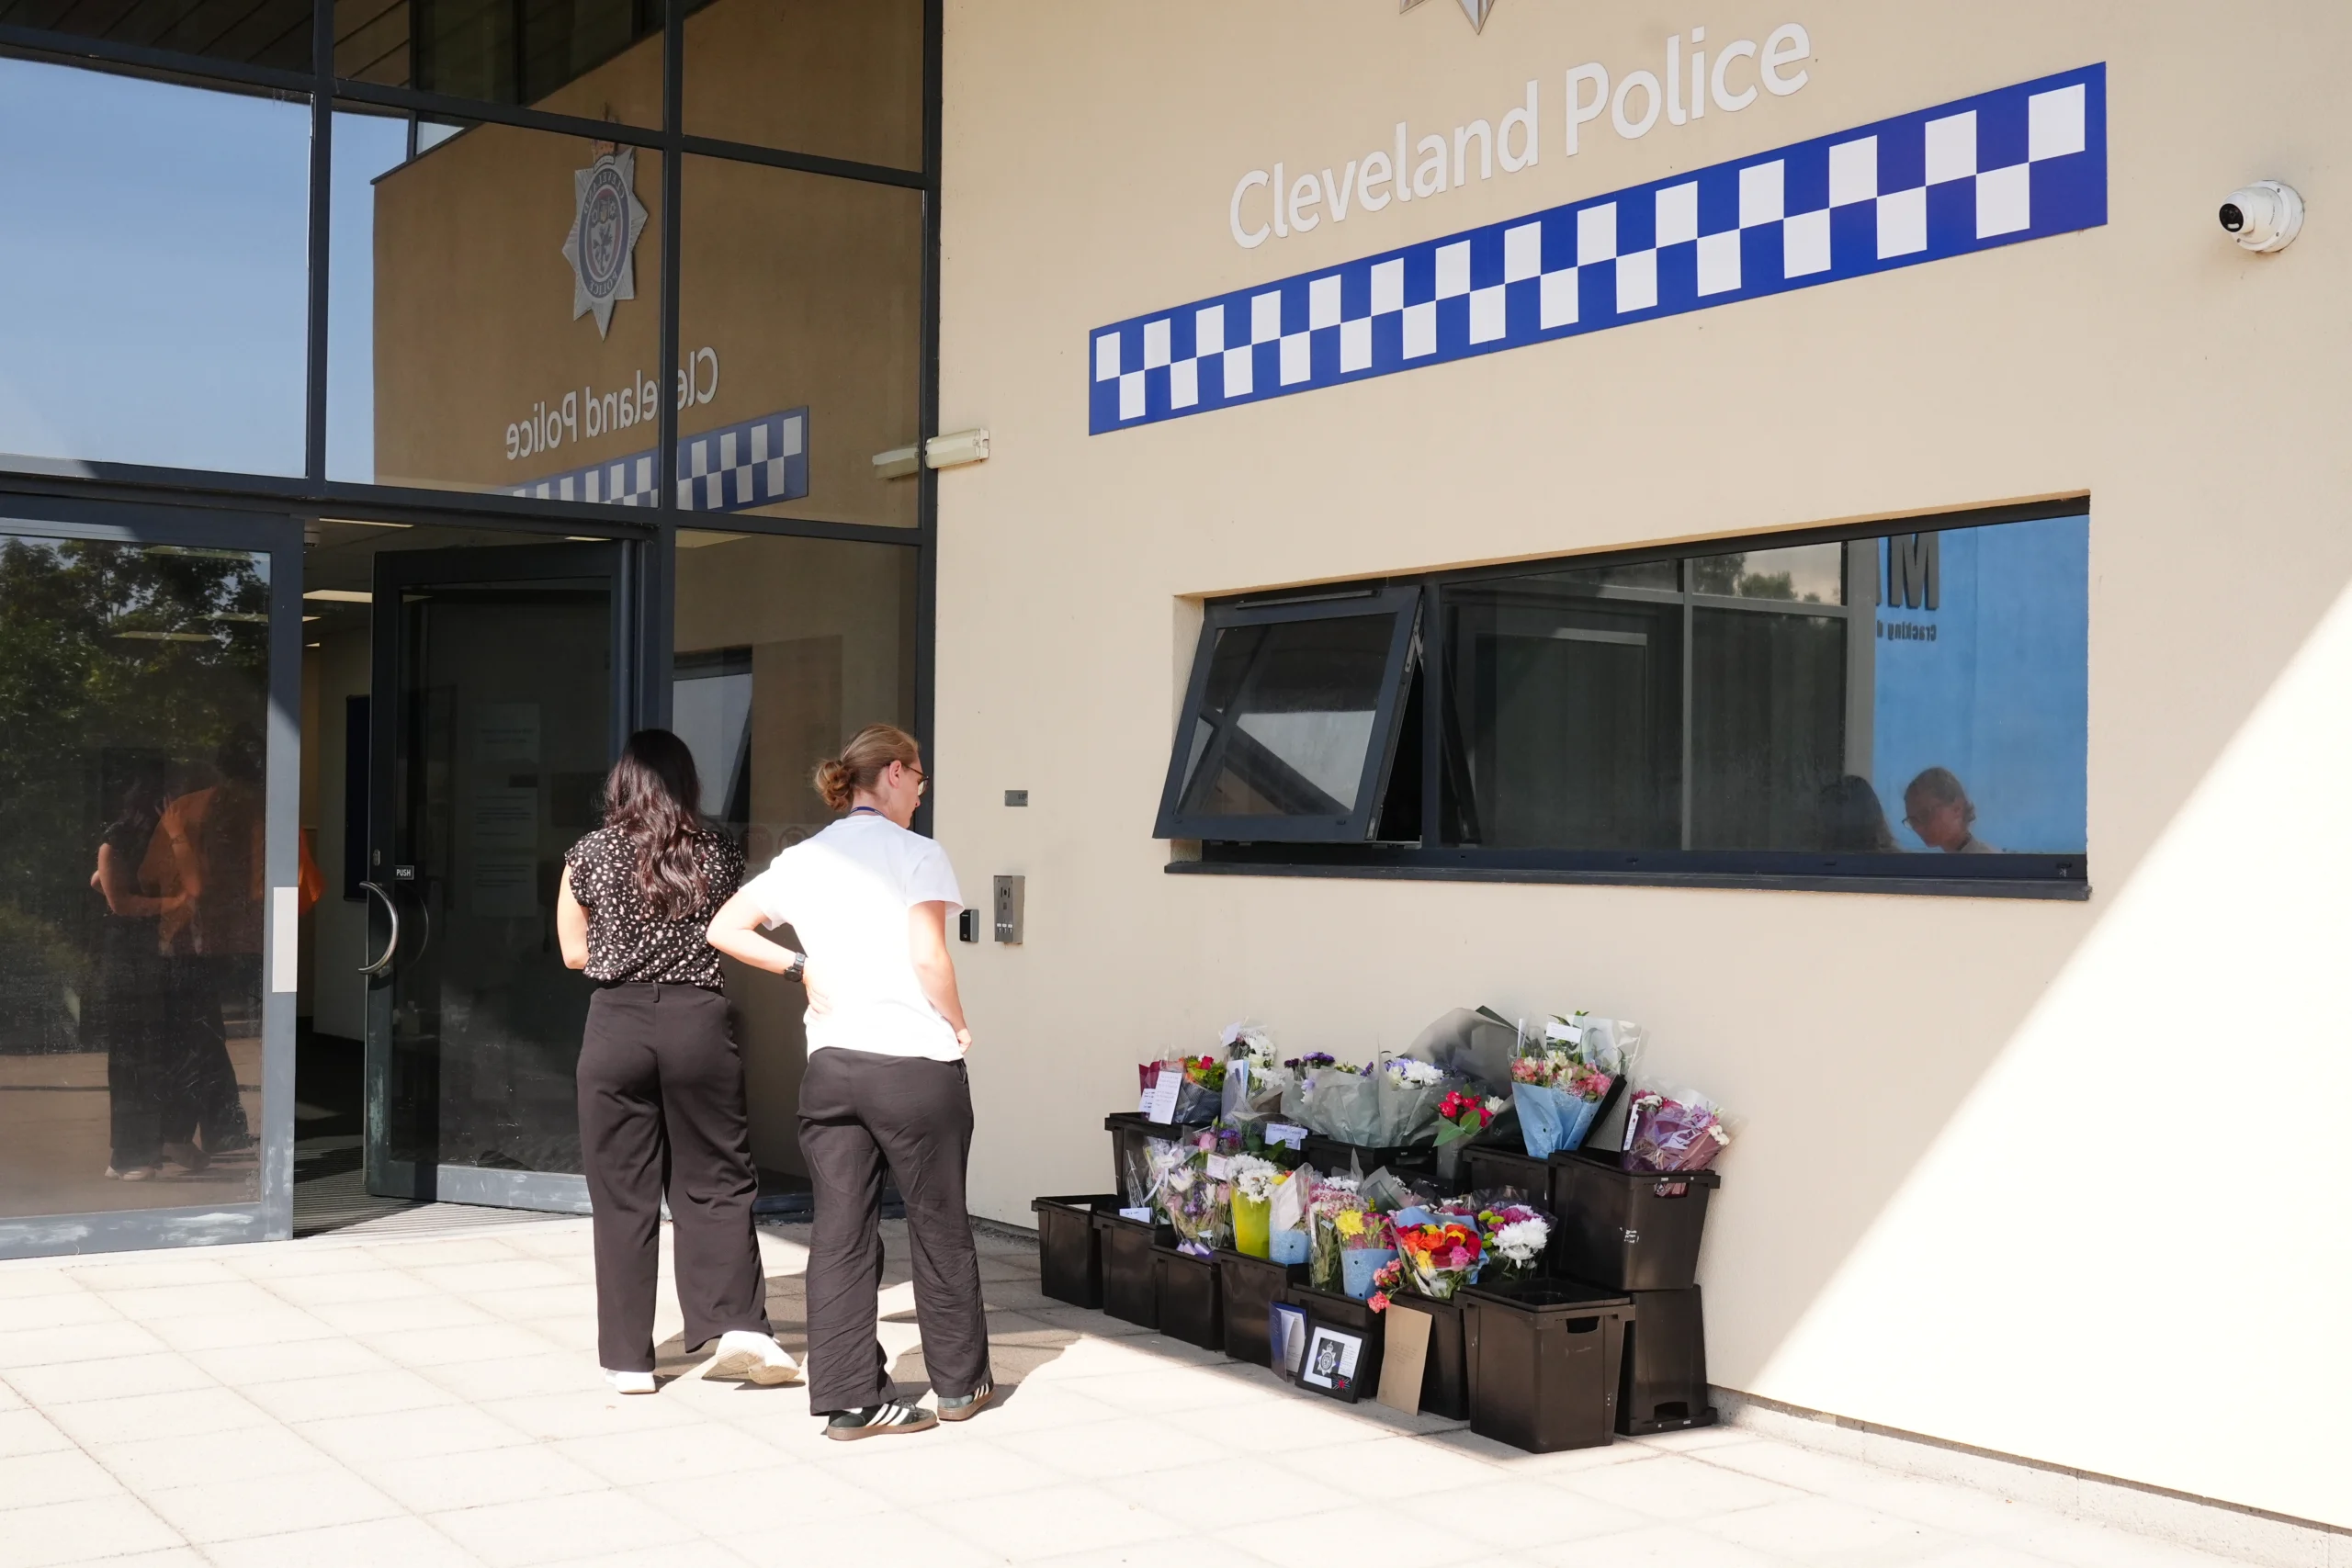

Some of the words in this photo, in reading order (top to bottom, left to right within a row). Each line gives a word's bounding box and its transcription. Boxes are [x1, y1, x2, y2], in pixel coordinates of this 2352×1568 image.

[1228, 79, 1540, 250] Cleveland
[1566, 22, 1812, 157] Police
[396, 868, 412, 877] PUSH
